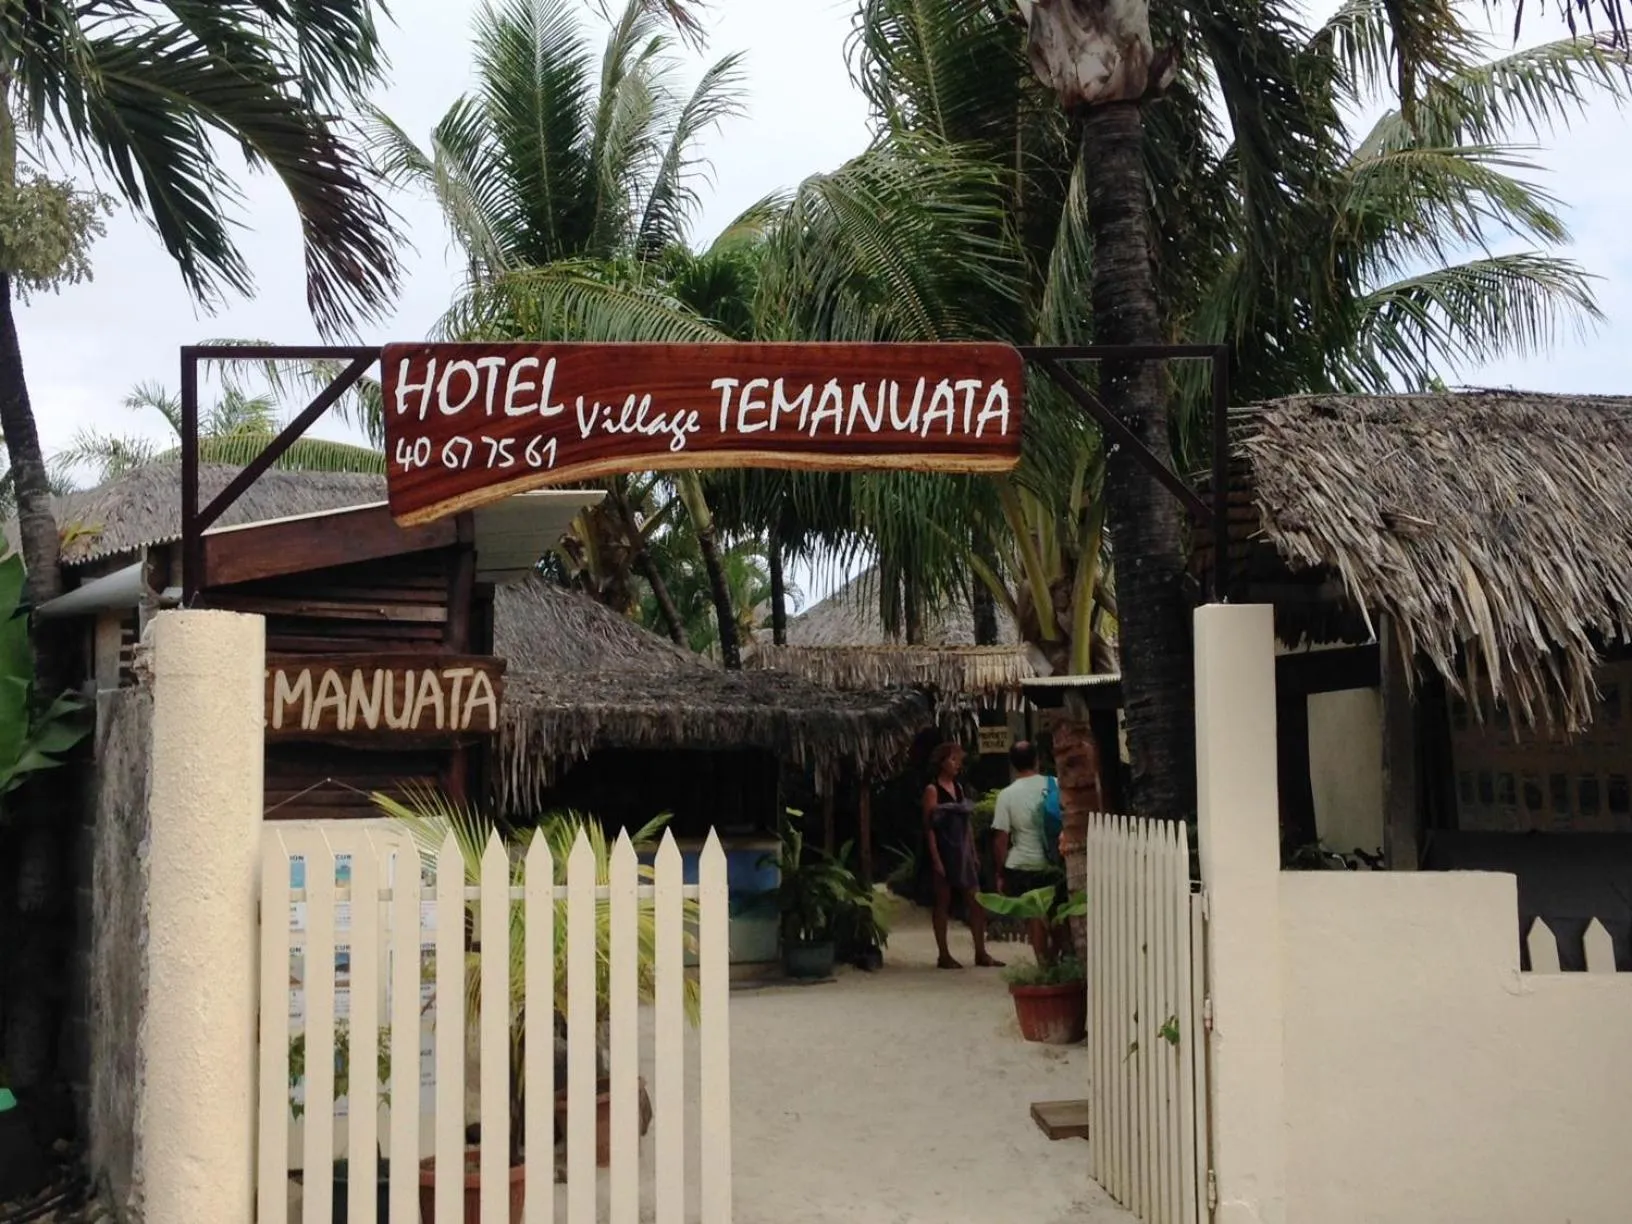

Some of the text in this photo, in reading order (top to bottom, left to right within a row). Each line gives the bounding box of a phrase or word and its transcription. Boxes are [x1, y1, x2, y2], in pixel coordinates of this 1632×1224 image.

[395, 357, 1009, 451] HOTEL Village TEMANUATA
[396, 435, 556, 472] 40 67 75 61
[265, 668, 497, 730] MANUATA
